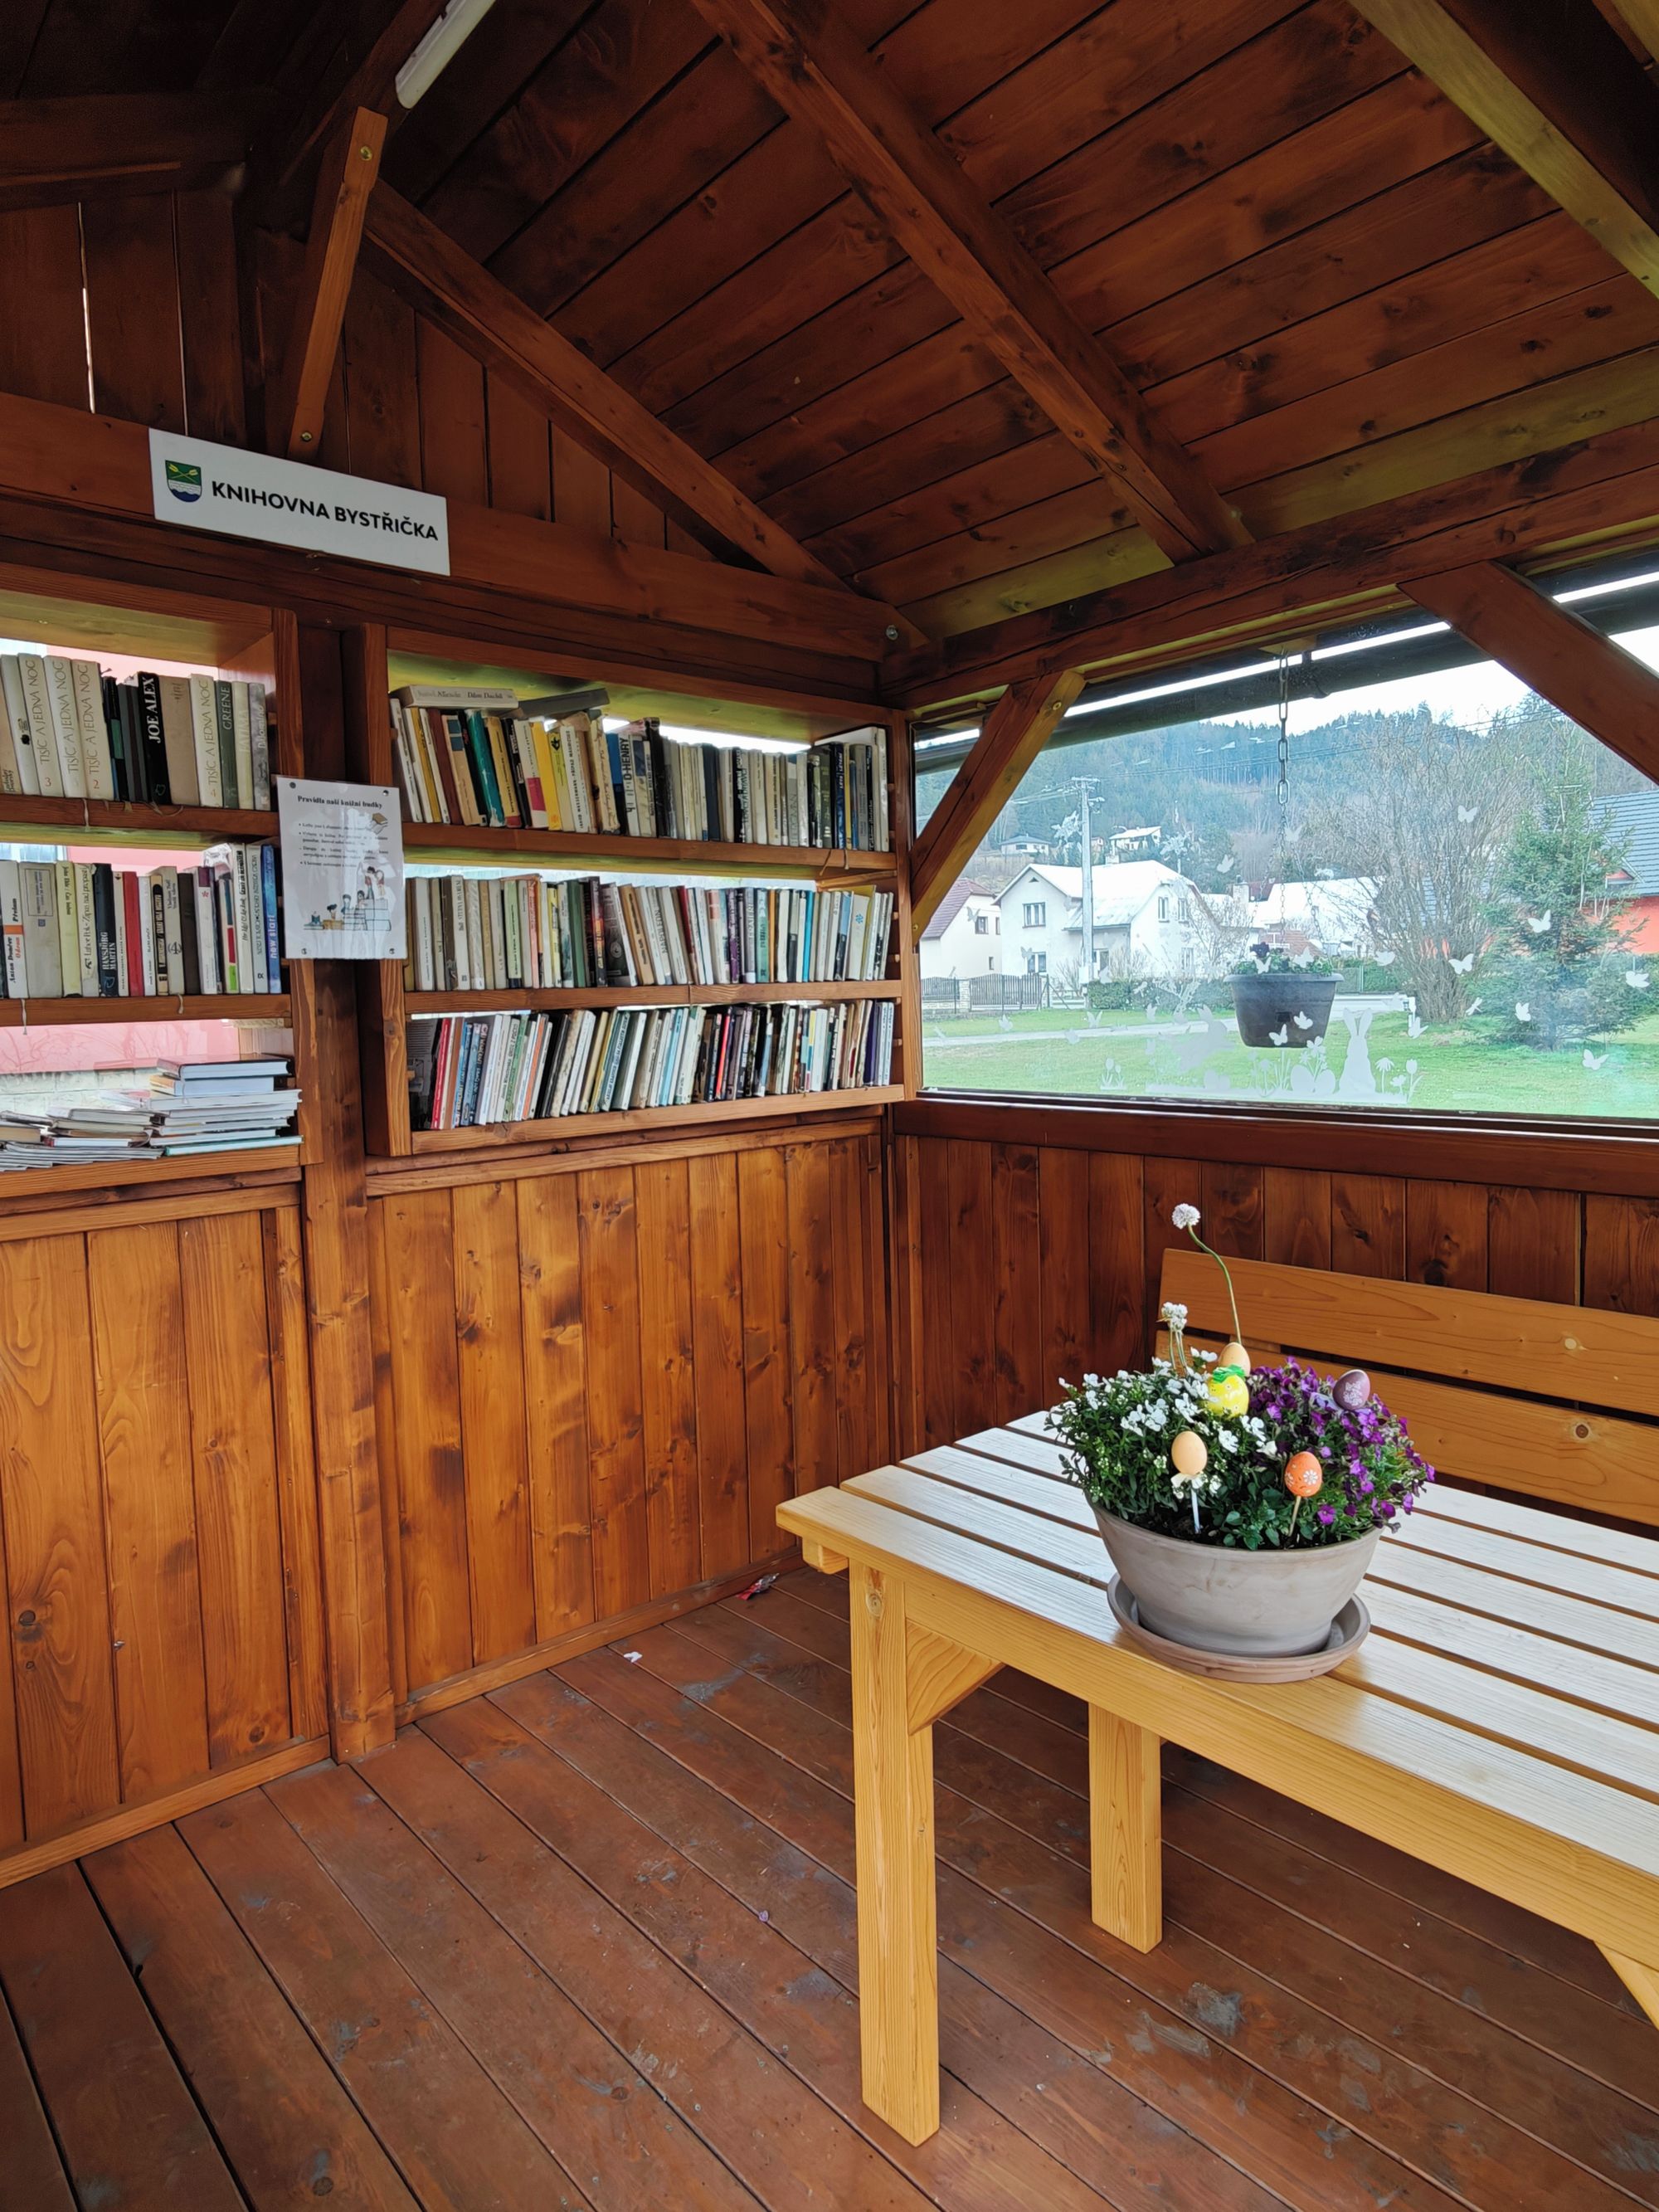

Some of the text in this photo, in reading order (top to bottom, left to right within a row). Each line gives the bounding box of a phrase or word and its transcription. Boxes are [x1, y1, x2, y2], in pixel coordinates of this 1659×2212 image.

[212, 480, 438, 541] KNIHOVNA BYSTŘIČKA
[26, 660, 51, 764] TISÍC A JEDNA NOC
[143, 677, 161, 743] JOE ALEX
[198, 680, 210, 706] NOC
[221, 687, 232, 730] GREENE
[52, 661, 79, 773] TISÍC A JEDNA NOC
[78, 665, 100, 774] TISÍC A JEDNA NOC
[202, 712, 216, 745] JEDNA
[45, 777, 51, 787] 3
[93, 779, 100, 789] 2
[207, 761, 218, 785] TISÍC
[298, 796, 324, 804] Pravidla
[99, 932, 109, 970] HANSJÖRG
[266, 914, 277, 958] new start
[654, 909, 668, 954] NAPOLEON
[109, 943, 117, 971] MARTIN
